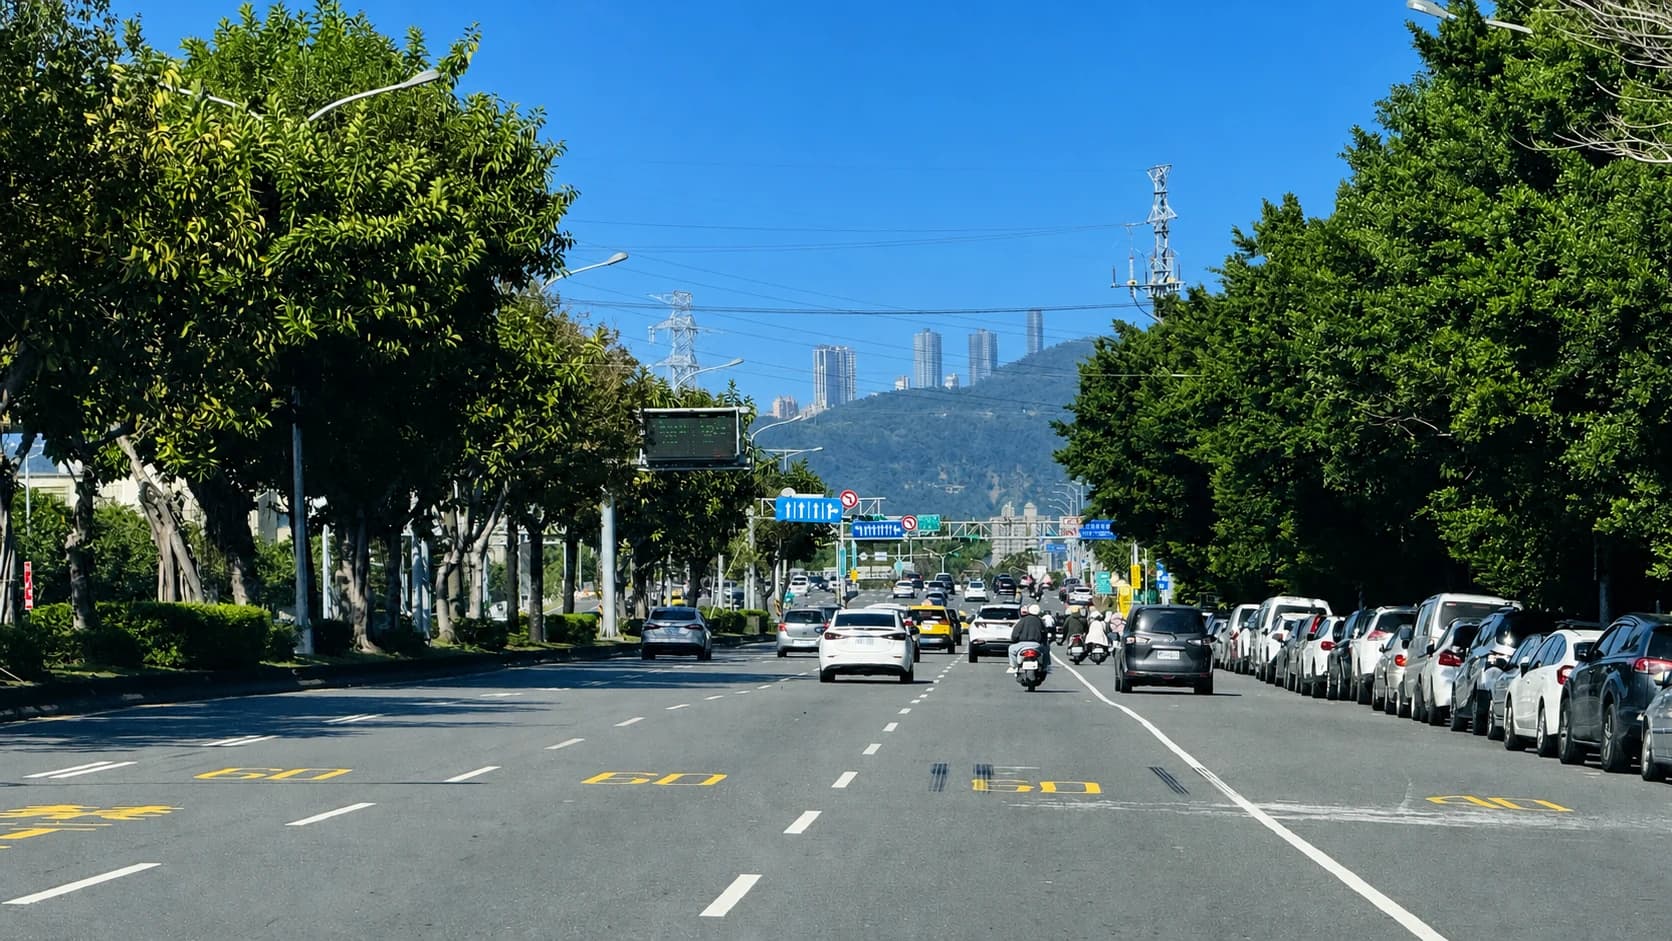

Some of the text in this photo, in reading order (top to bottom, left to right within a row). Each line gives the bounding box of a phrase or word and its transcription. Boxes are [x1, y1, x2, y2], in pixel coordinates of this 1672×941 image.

[193, 766, 352, 781] 60
[581, 770, 728, 787] 60
[971, 778, 1103, 795] 60
